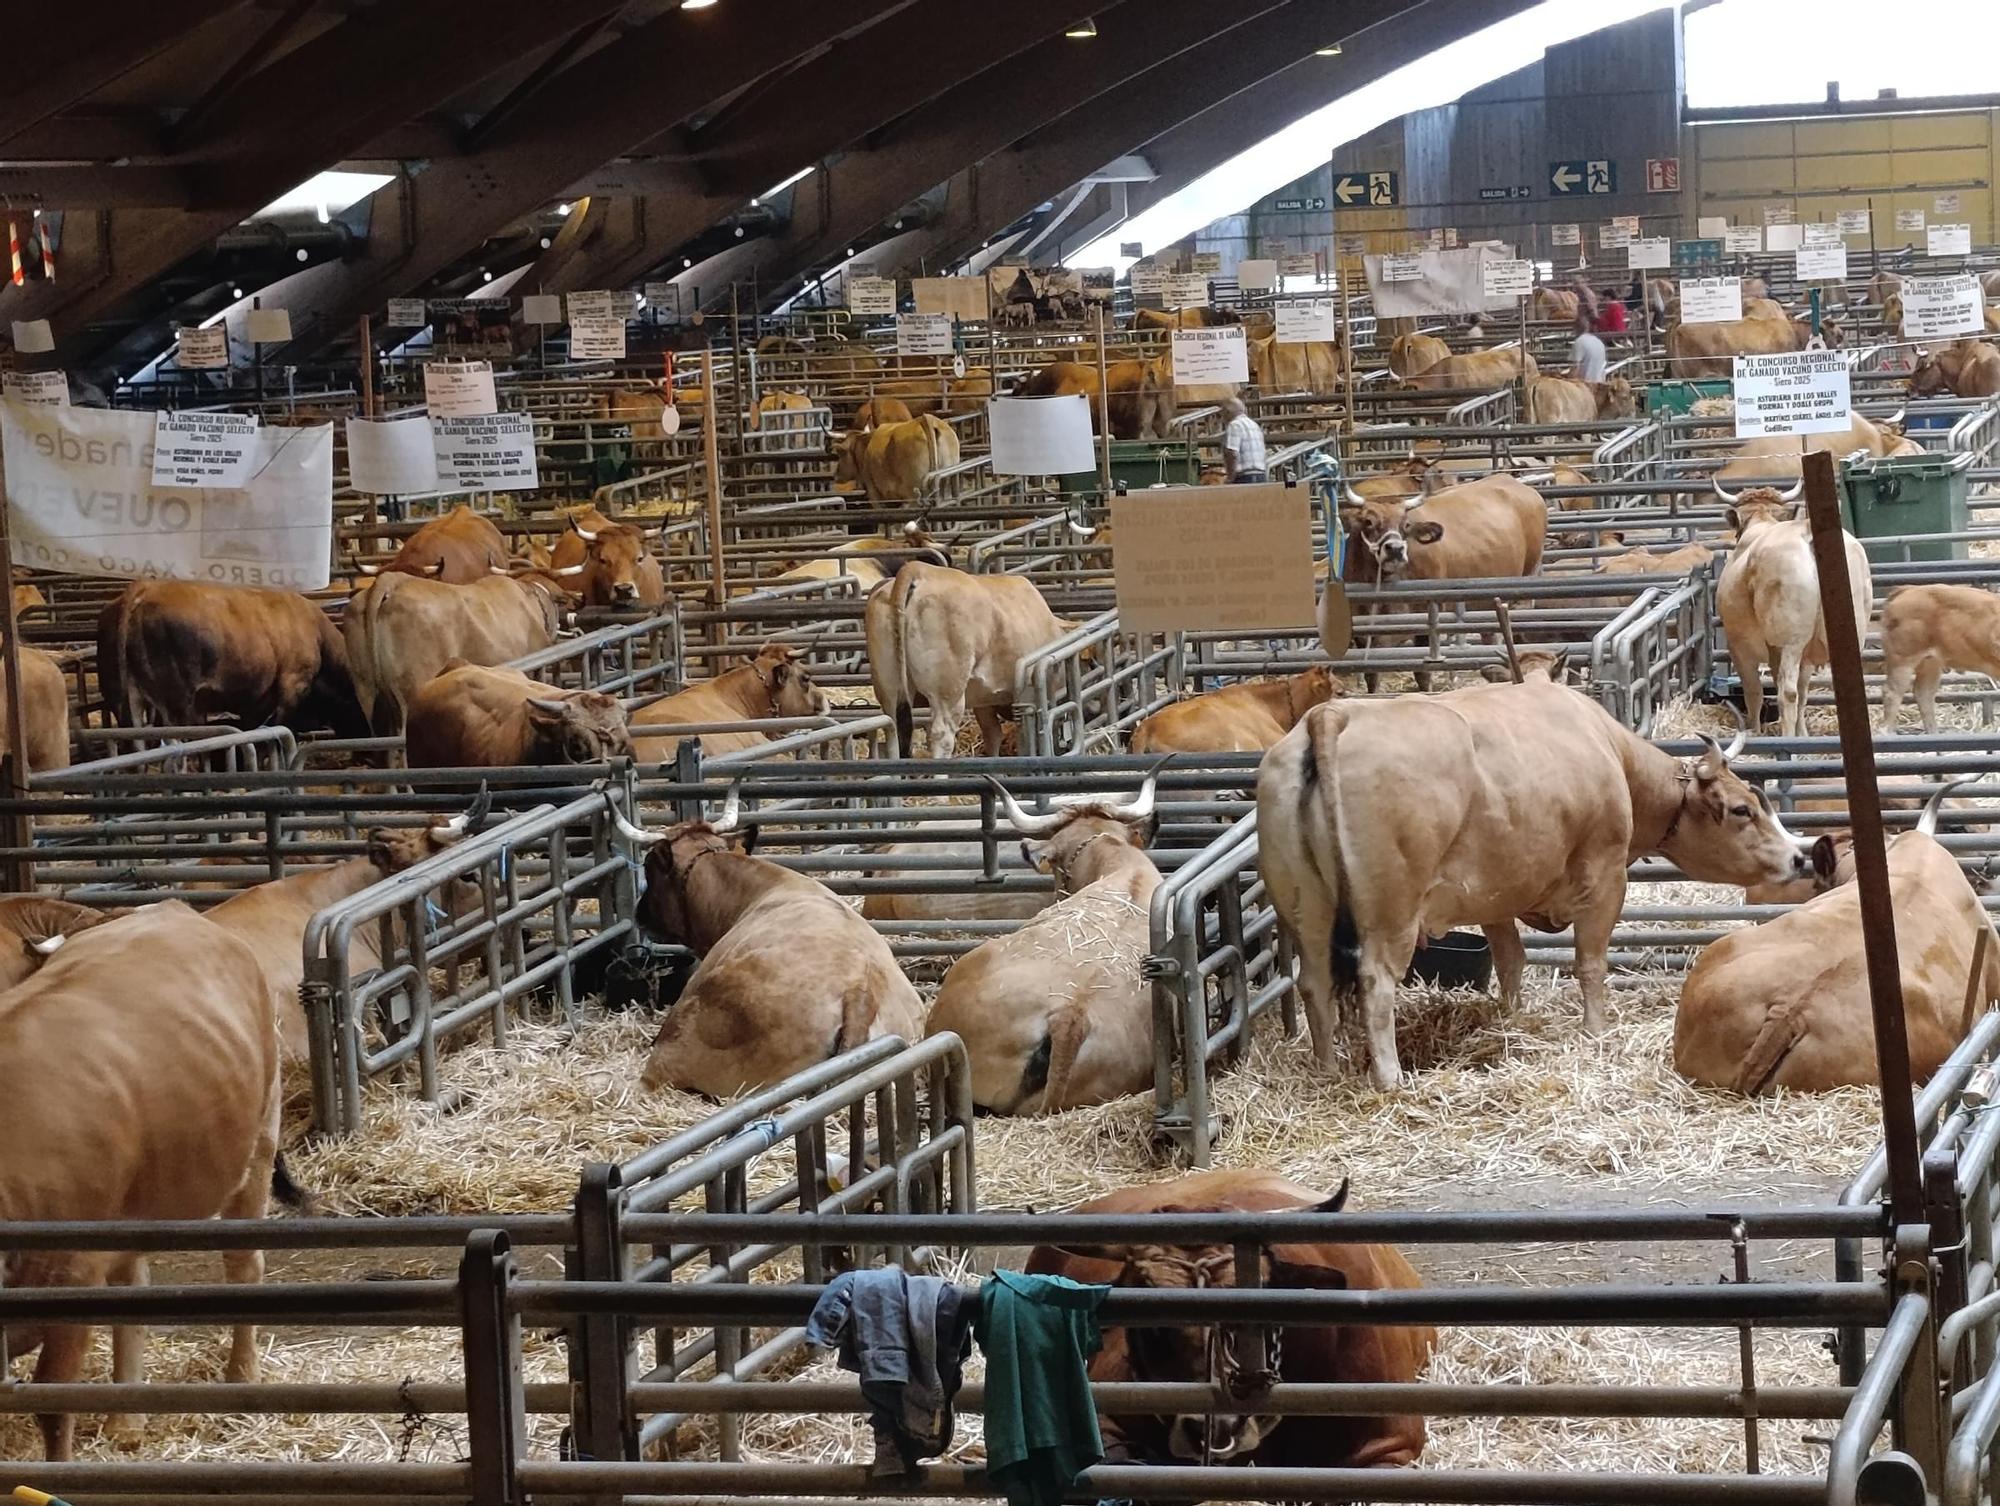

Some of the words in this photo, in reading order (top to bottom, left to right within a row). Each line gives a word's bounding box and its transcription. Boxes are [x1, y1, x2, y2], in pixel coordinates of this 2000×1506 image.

[1277, 201, 1301, 209] SALIDA
[1746, 359, 1754, 367] XL
[1758, 357, 1797, 367] CONCURSO
[1800, 354, 1835, 364] REGIONAL
[1737, 369, 1746, 378] DE
[1749, 367, 1779, 377] GANADO
[1782, 365, 1812, 375] VACUNO
[1814, 362, 1846, 373] SELECTO
[1774, 378, 1792, 386] Siero
[1794, 376, 1811, 385] 2025
[168, 414, 175, 422] XL
[178, 414, 213, 424] CONCURSO
[215, 416, 247, 426] REGIONAL
[441, 418, 448, 426] XL
[451, 417, 485, 426] CONCURSO
[487, 416, 520, 425] REGIONAL
[159, 423, 167, 431] DE
[170, 423, 196, 432] GANADO
[199, 424, 224, 433] VACUNO
[227, 425, 254, 434] SELECTO
[434, 427, 442, 435] DE
[445, 426, 469, 435] GANADO
[472, 426, 498, 435] VACUNO
[500, 424, 531, 434] SELECTO
